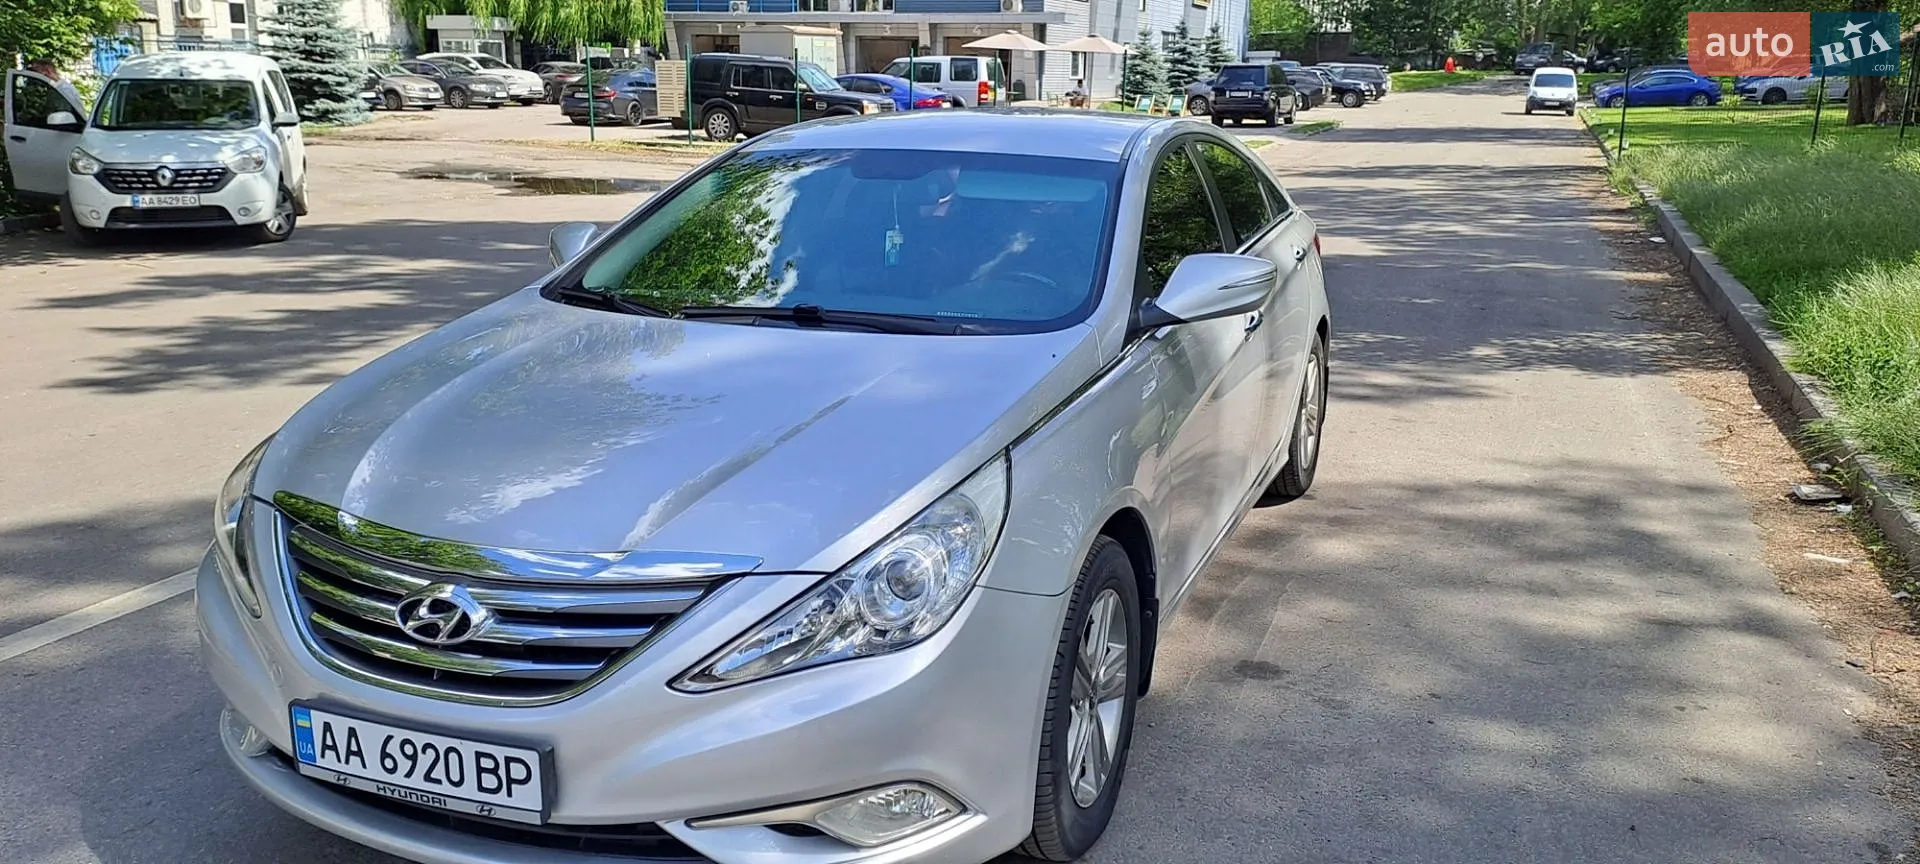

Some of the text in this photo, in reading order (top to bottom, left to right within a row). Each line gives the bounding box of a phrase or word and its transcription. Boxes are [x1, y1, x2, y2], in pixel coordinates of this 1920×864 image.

[882, 24, 891, 35] 3
[141, 195, 197, 206] AA 8429 EO
[299, 741, 314, 757] UA
[320, 721, 532, 798] AA 6920 BP
[376, 784, 447, 807] HYUNDAI
